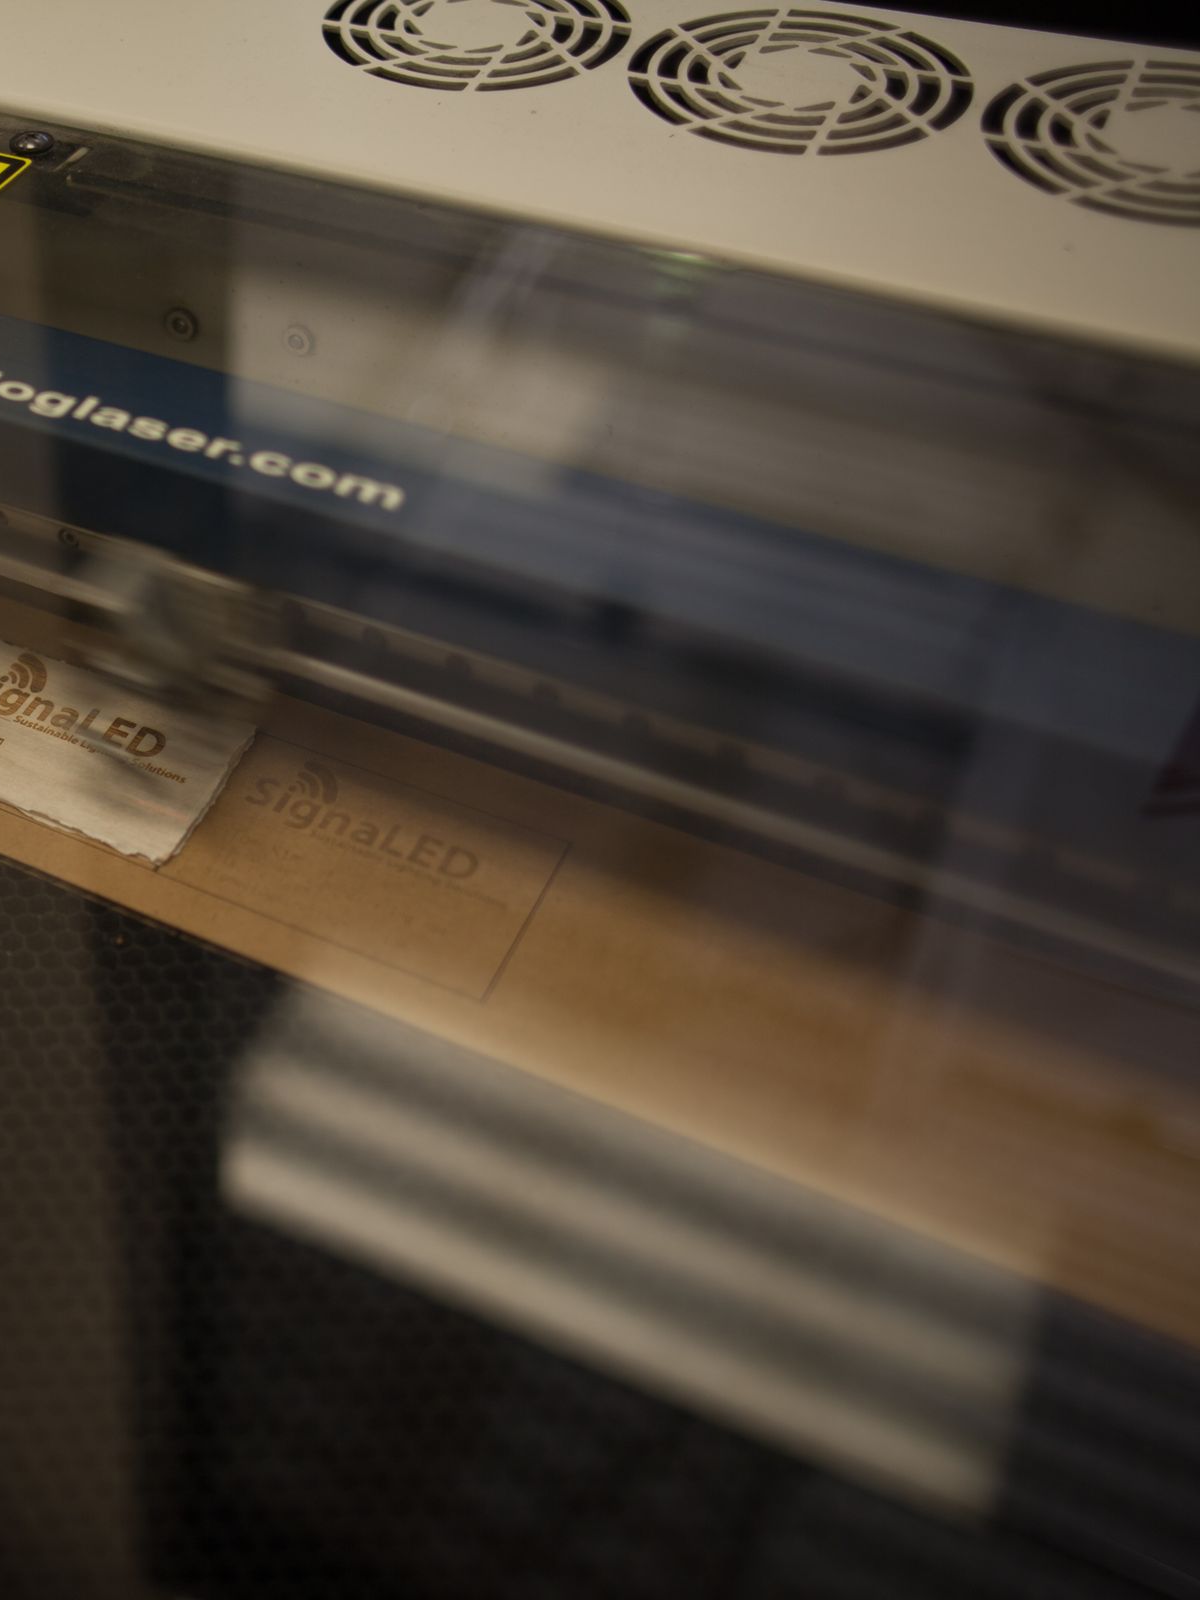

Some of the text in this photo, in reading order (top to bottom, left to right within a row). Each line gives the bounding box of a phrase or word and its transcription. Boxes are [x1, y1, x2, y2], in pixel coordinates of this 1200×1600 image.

[13, 715, 187, 784] Sustainable Solutions
[245, 777, 478, 880] SignaLED
